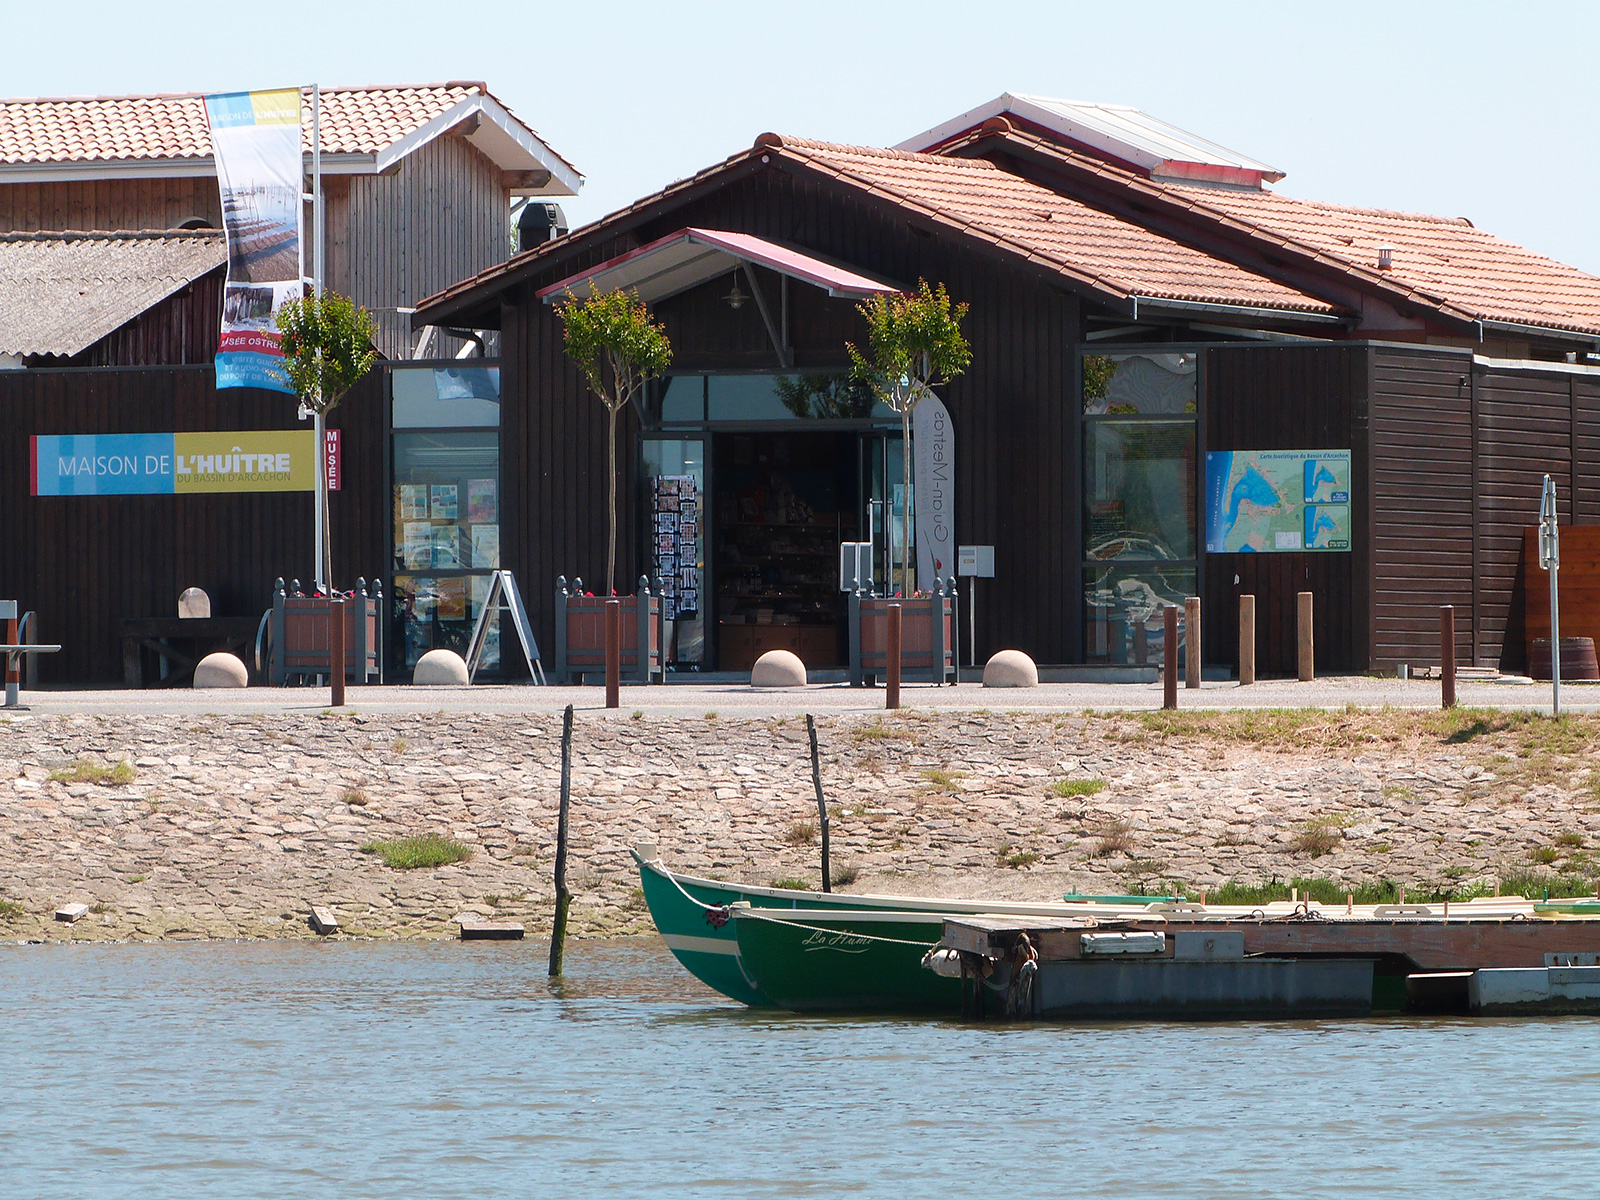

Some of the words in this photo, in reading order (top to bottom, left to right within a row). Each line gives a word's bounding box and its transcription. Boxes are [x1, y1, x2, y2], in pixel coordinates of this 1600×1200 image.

[243, 111, 253, 119] DE
[58, 455, 138, 476] MAISON
[145, 455, 170, 474] DE
[176, 446, 291, 474] L'HUÎTRE
[326, 431, 337, 489] MUSÉE
[177, 473, 191, 483] DU
[193, 473, 225, 483] BASSIN
[228, 472, 291, 482] D'ARCACHON
[801, 929, 826, 946] La
